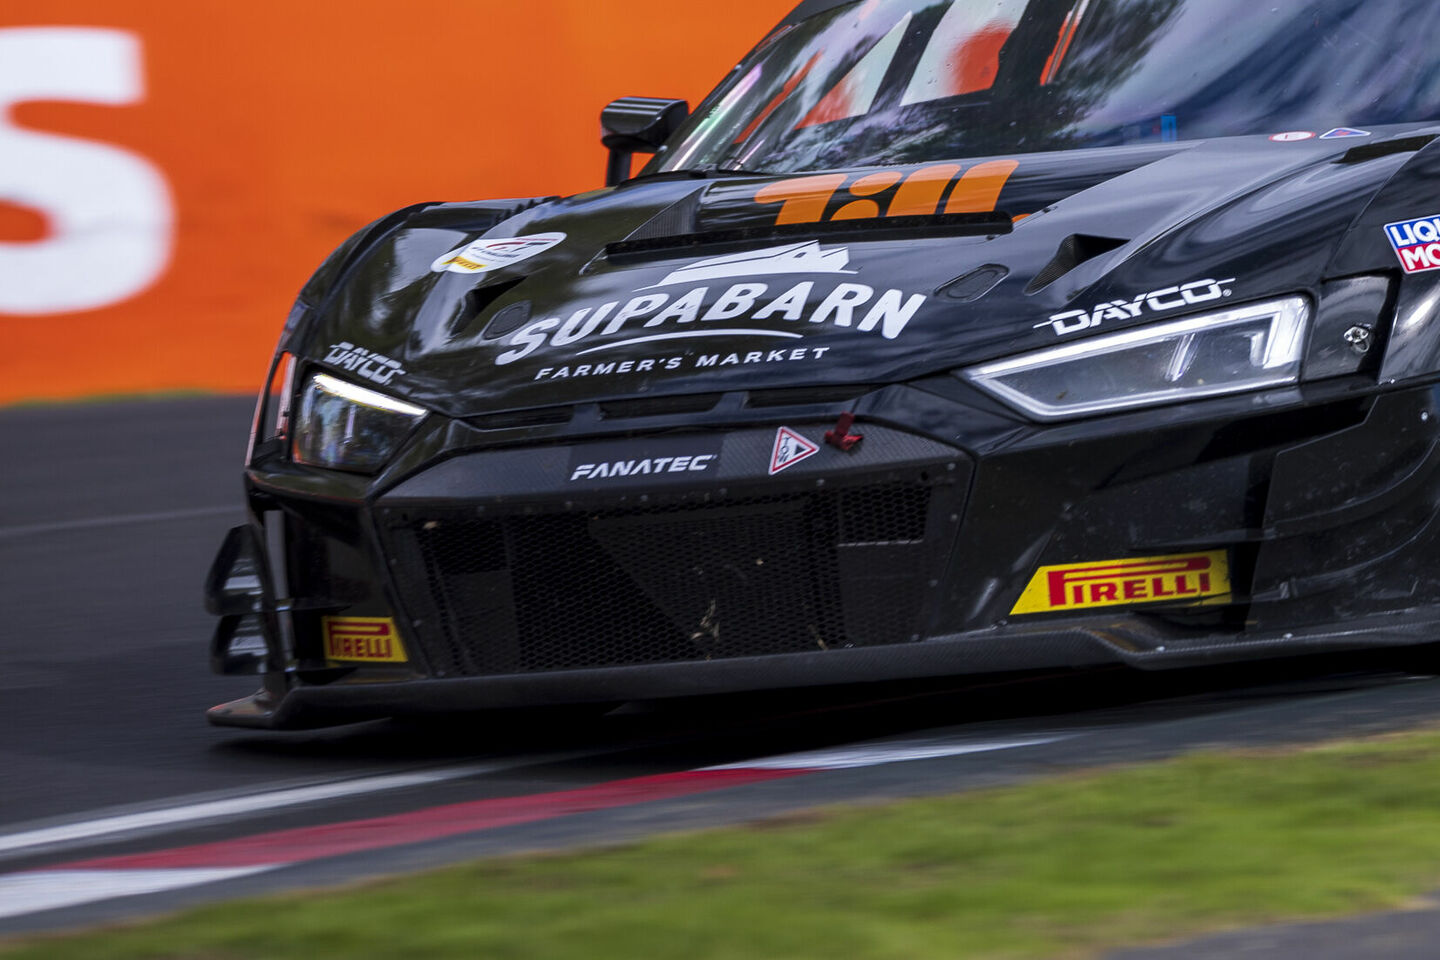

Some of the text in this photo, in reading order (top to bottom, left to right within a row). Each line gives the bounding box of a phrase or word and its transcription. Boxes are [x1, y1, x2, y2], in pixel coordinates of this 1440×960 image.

[494, 281, 928, 366] SUPABARN
[1033, 277, 1237, 337] DAYCO
[323, 341, 407, 386] DAYCO
[534, 346, 831, 381] FARMER'S MARKET
[570, 454, 714, 481] FANATEC
[1046, 555, 1212, 608] PIRELLI
[326, 621, 392, 658] PIRELLI
